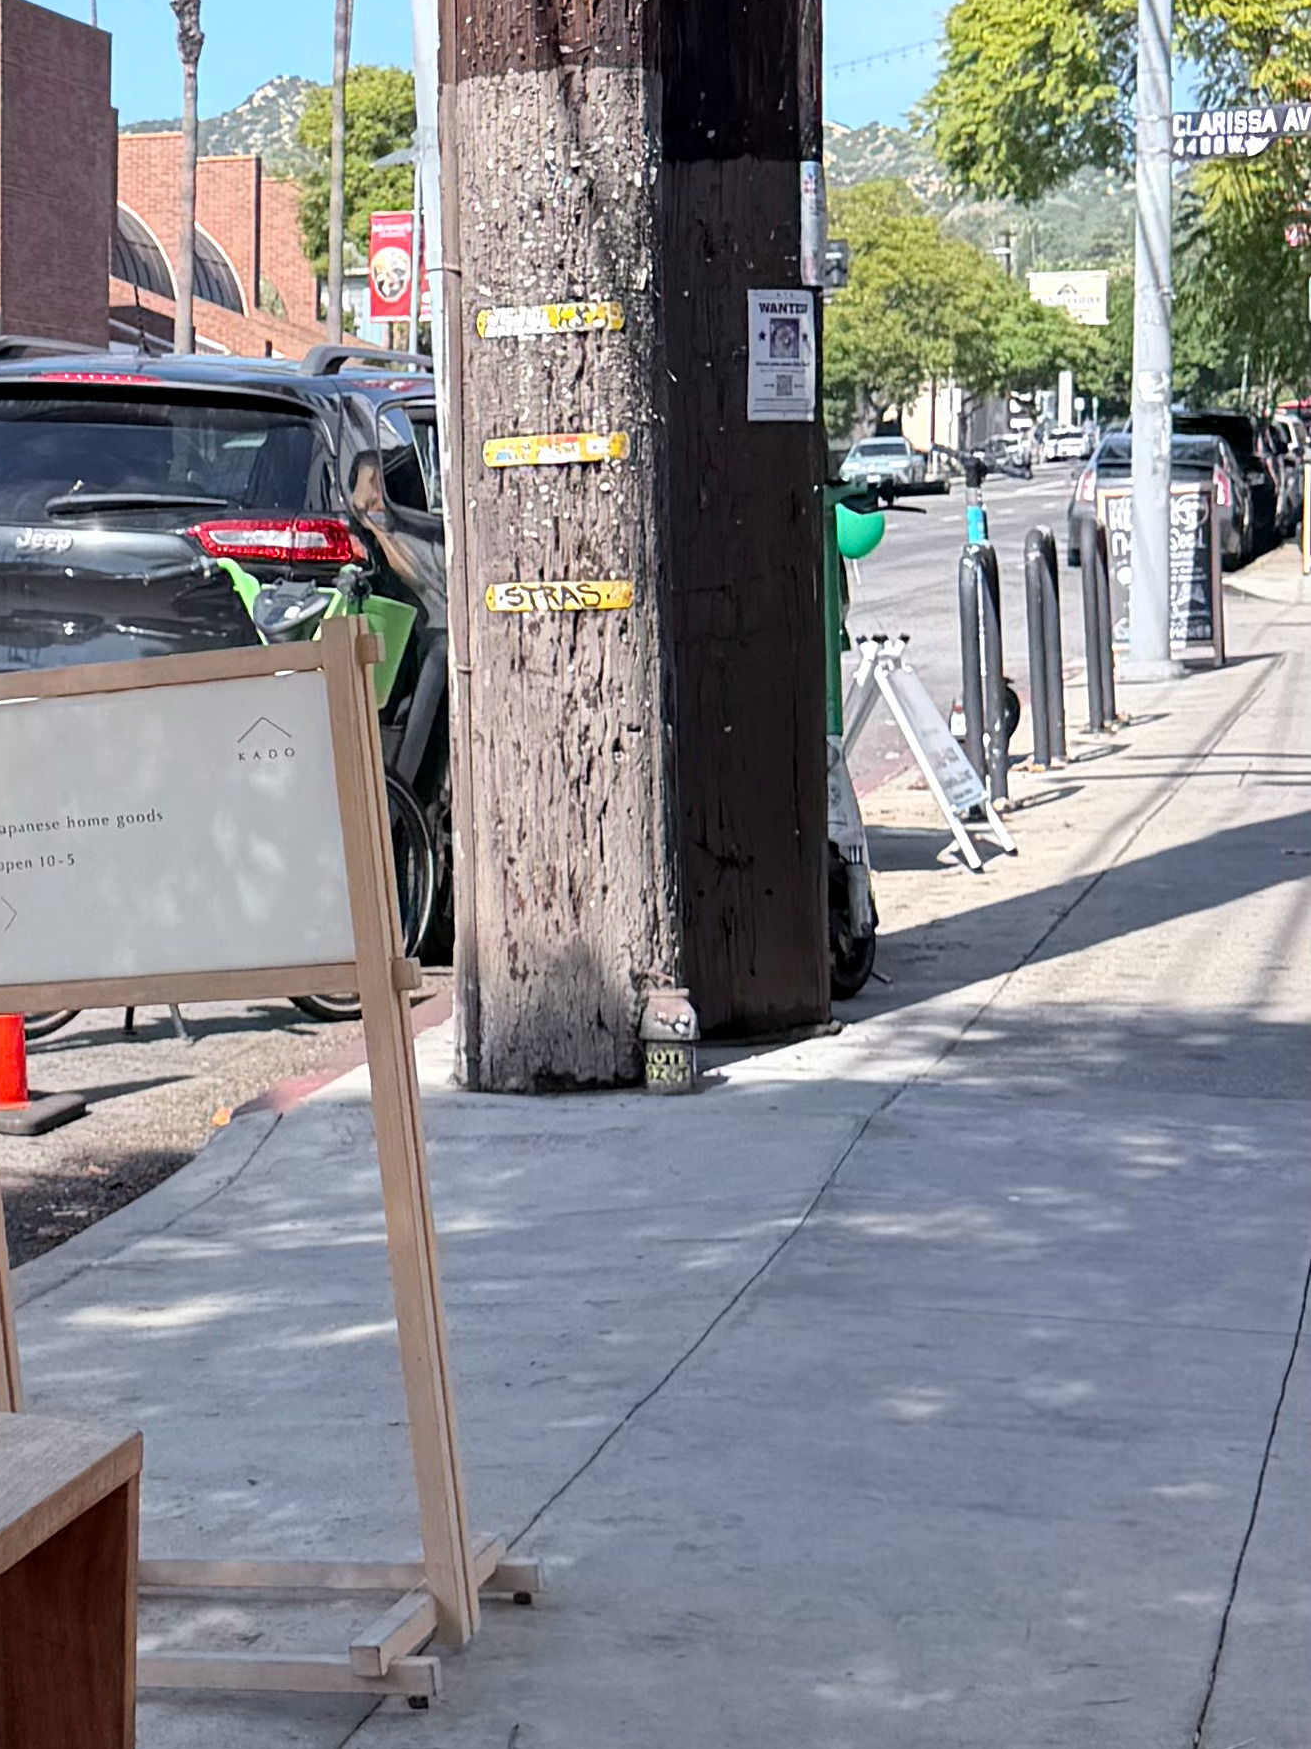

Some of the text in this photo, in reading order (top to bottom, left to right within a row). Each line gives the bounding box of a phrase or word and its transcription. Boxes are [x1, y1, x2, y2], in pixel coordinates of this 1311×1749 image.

[1172, 108, 1277, 138] CLARISSA
[758, 302, 808, 314] WANTED
[15, 526, 74, 553] Jeep
[237, 746, 296, 762] KADO
[66, 814, 110, 830] home
[116, 807, 164, 830] goods
